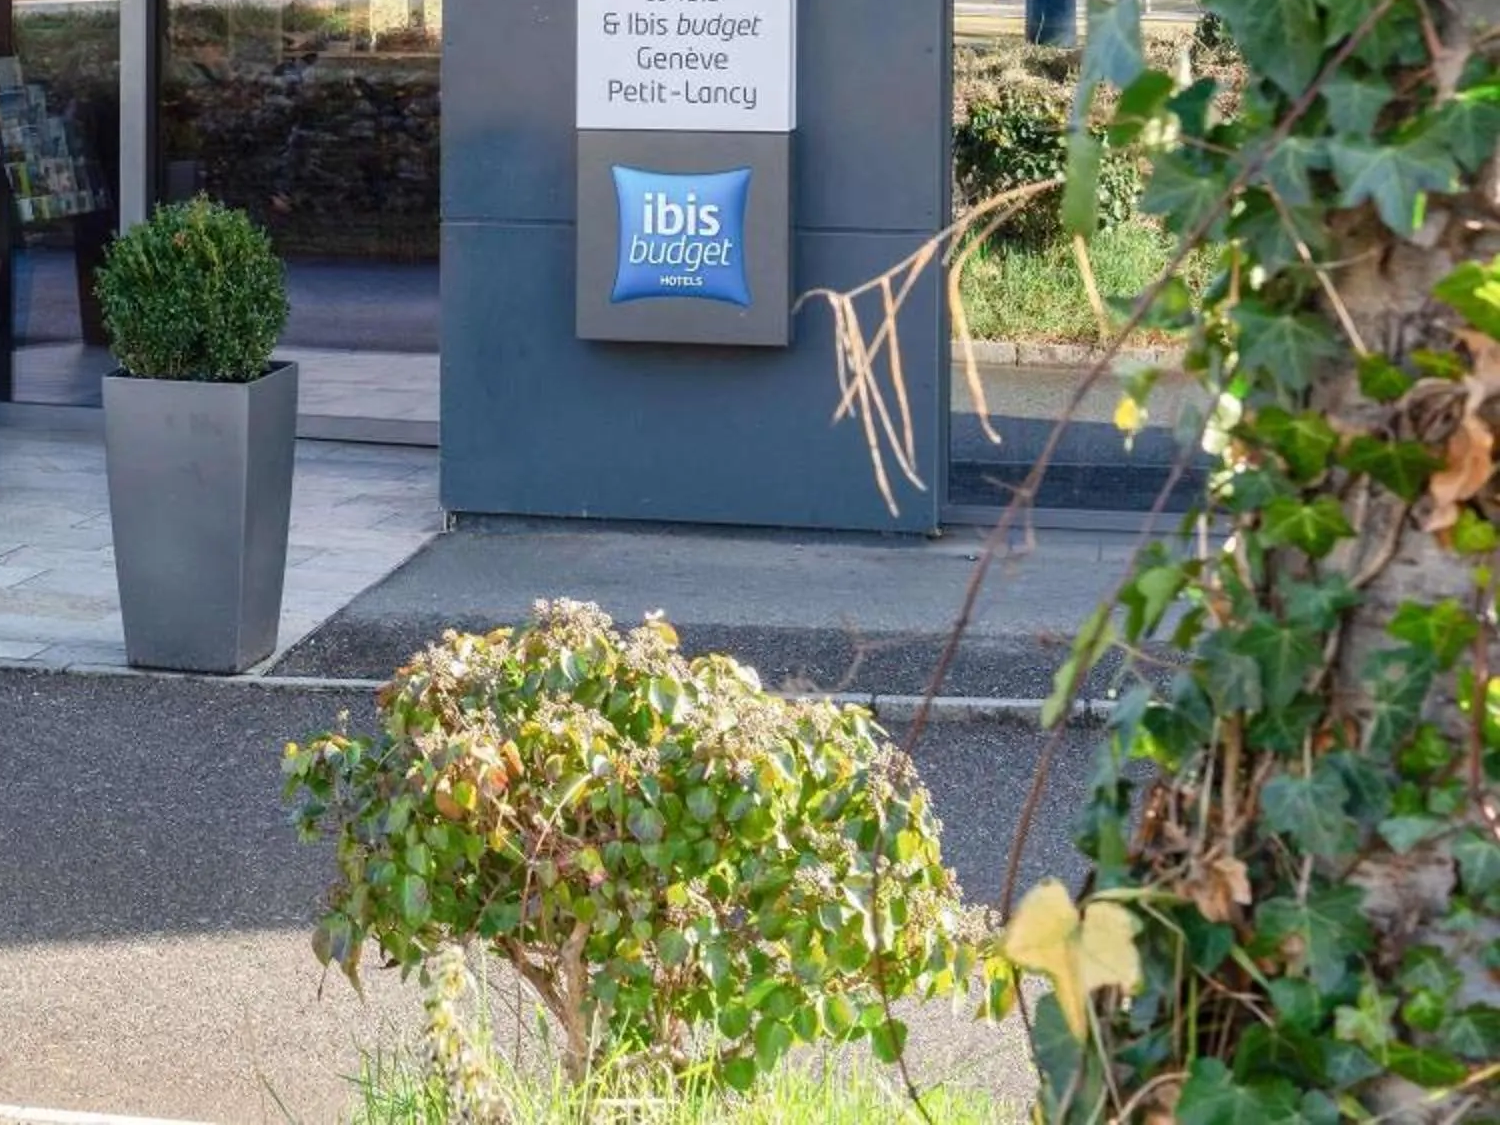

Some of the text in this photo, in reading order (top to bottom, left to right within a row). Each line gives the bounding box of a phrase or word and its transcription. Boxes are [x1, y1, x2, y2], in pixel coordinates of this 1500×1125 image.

[603, 12, 763, 42] & Ibis budget
[644, 192, 720, 236] ibis
[629, 234, 733, 271] budget
[660, 275, 703, 286] HOTELS
